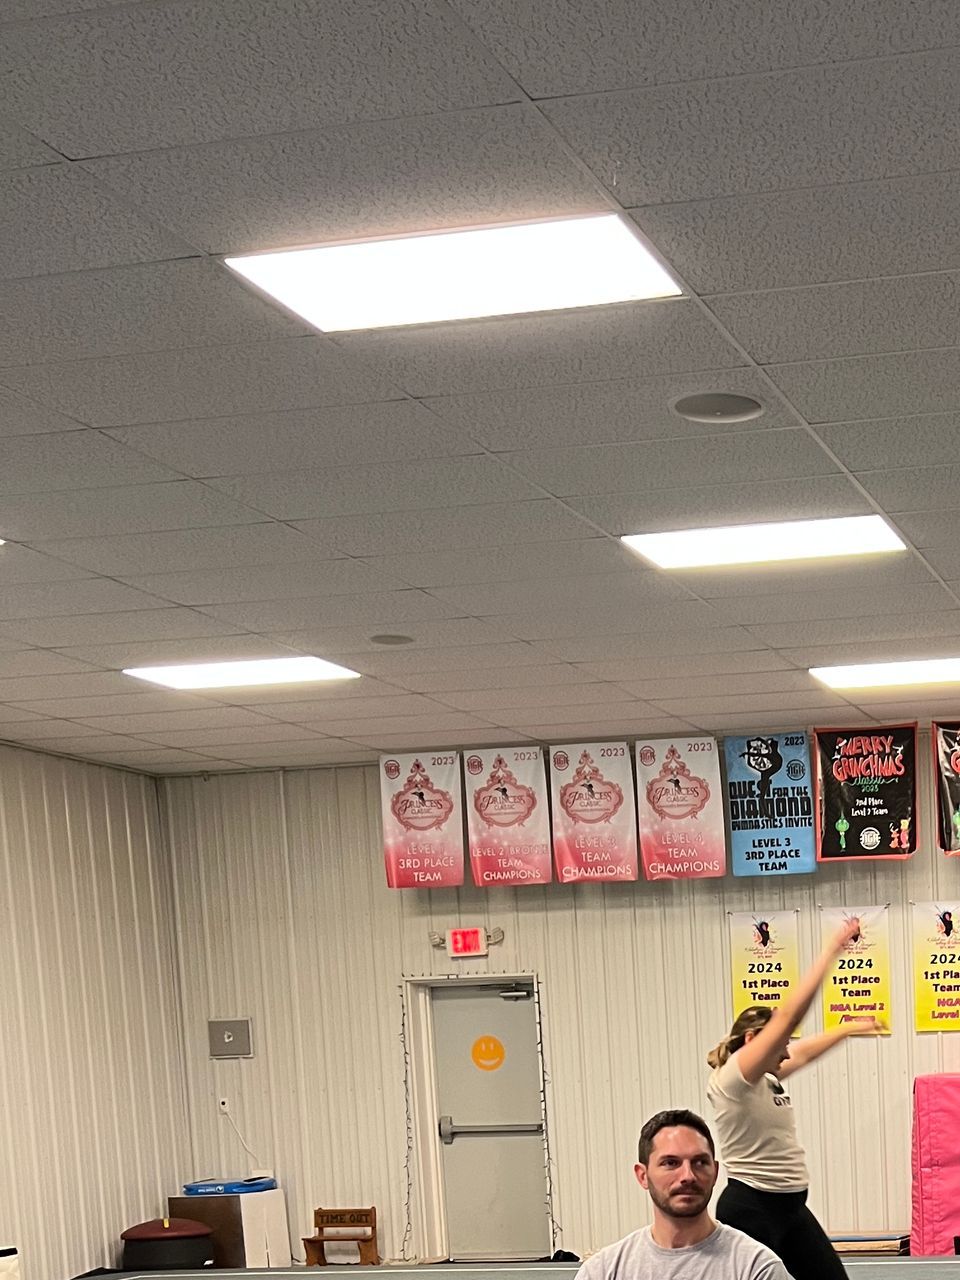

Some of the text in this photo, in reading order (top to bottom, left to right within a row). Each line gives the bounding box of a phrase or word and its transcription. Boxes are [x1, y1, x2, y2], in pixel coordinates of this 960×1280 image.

[784, 736, 805, 746] 2023
[840, 736, 894, 756] MERRY
[601, 748, 625, 757] 2023
[687, 743, 712, 752] 2023
[432, 757, 454, 766] 2023
[514, 752, 538, 761] 2023
[833, 754, 905, 781] GRINCHMAS
[729, 779, 772, 799] QUEST
[772, 787, 788, 798] FOR
[730, 797, 812, 820] DIAMOND
[873, 808, 889, 816] Team
[785, 817, 812, 828] INVITE
[575, 837, 603, 849] LEVEL
[662, 833, 690, 845] LEVEL
[752, 838, 791, 849] LEVEL 3
[472, 847, 496, 857] LEVEL
[499, 847, 504, 856] 2
[581, 852, 611, 862] TEAM
[668, 848, 698, 859] TEAM
[745, 849, 801, 861] 3RD PLACE
[399, 856, 454, 869] 3RD PLACE
[497, 858, 524, 868] TEAM
[649, 861, 720, 874] CHAMPIONS
[759, 862, 788, 872] TEAM
[483, 869, 541, 881] CHAMPIONS
[562, 865, 632, 877] CHAMPIONS
[413, 871, 442, 882] TEAM
[748, 963, 782, 973] 2024
[838, 958, 873, 969] 2024
[833, 975, 880, 985] 1st Place
[924, 970, 940, 980] 1st
[742, 979, 789, 989] 1st Place
[751, 992, 781, 1001] Team
[841, 988, 871, 997] Team
[830, 1002, 885, 1012] NGA Level 2
[931, 1010, 959, 1019] Level
[319, 1213, 370, 1224] TIME OUT
